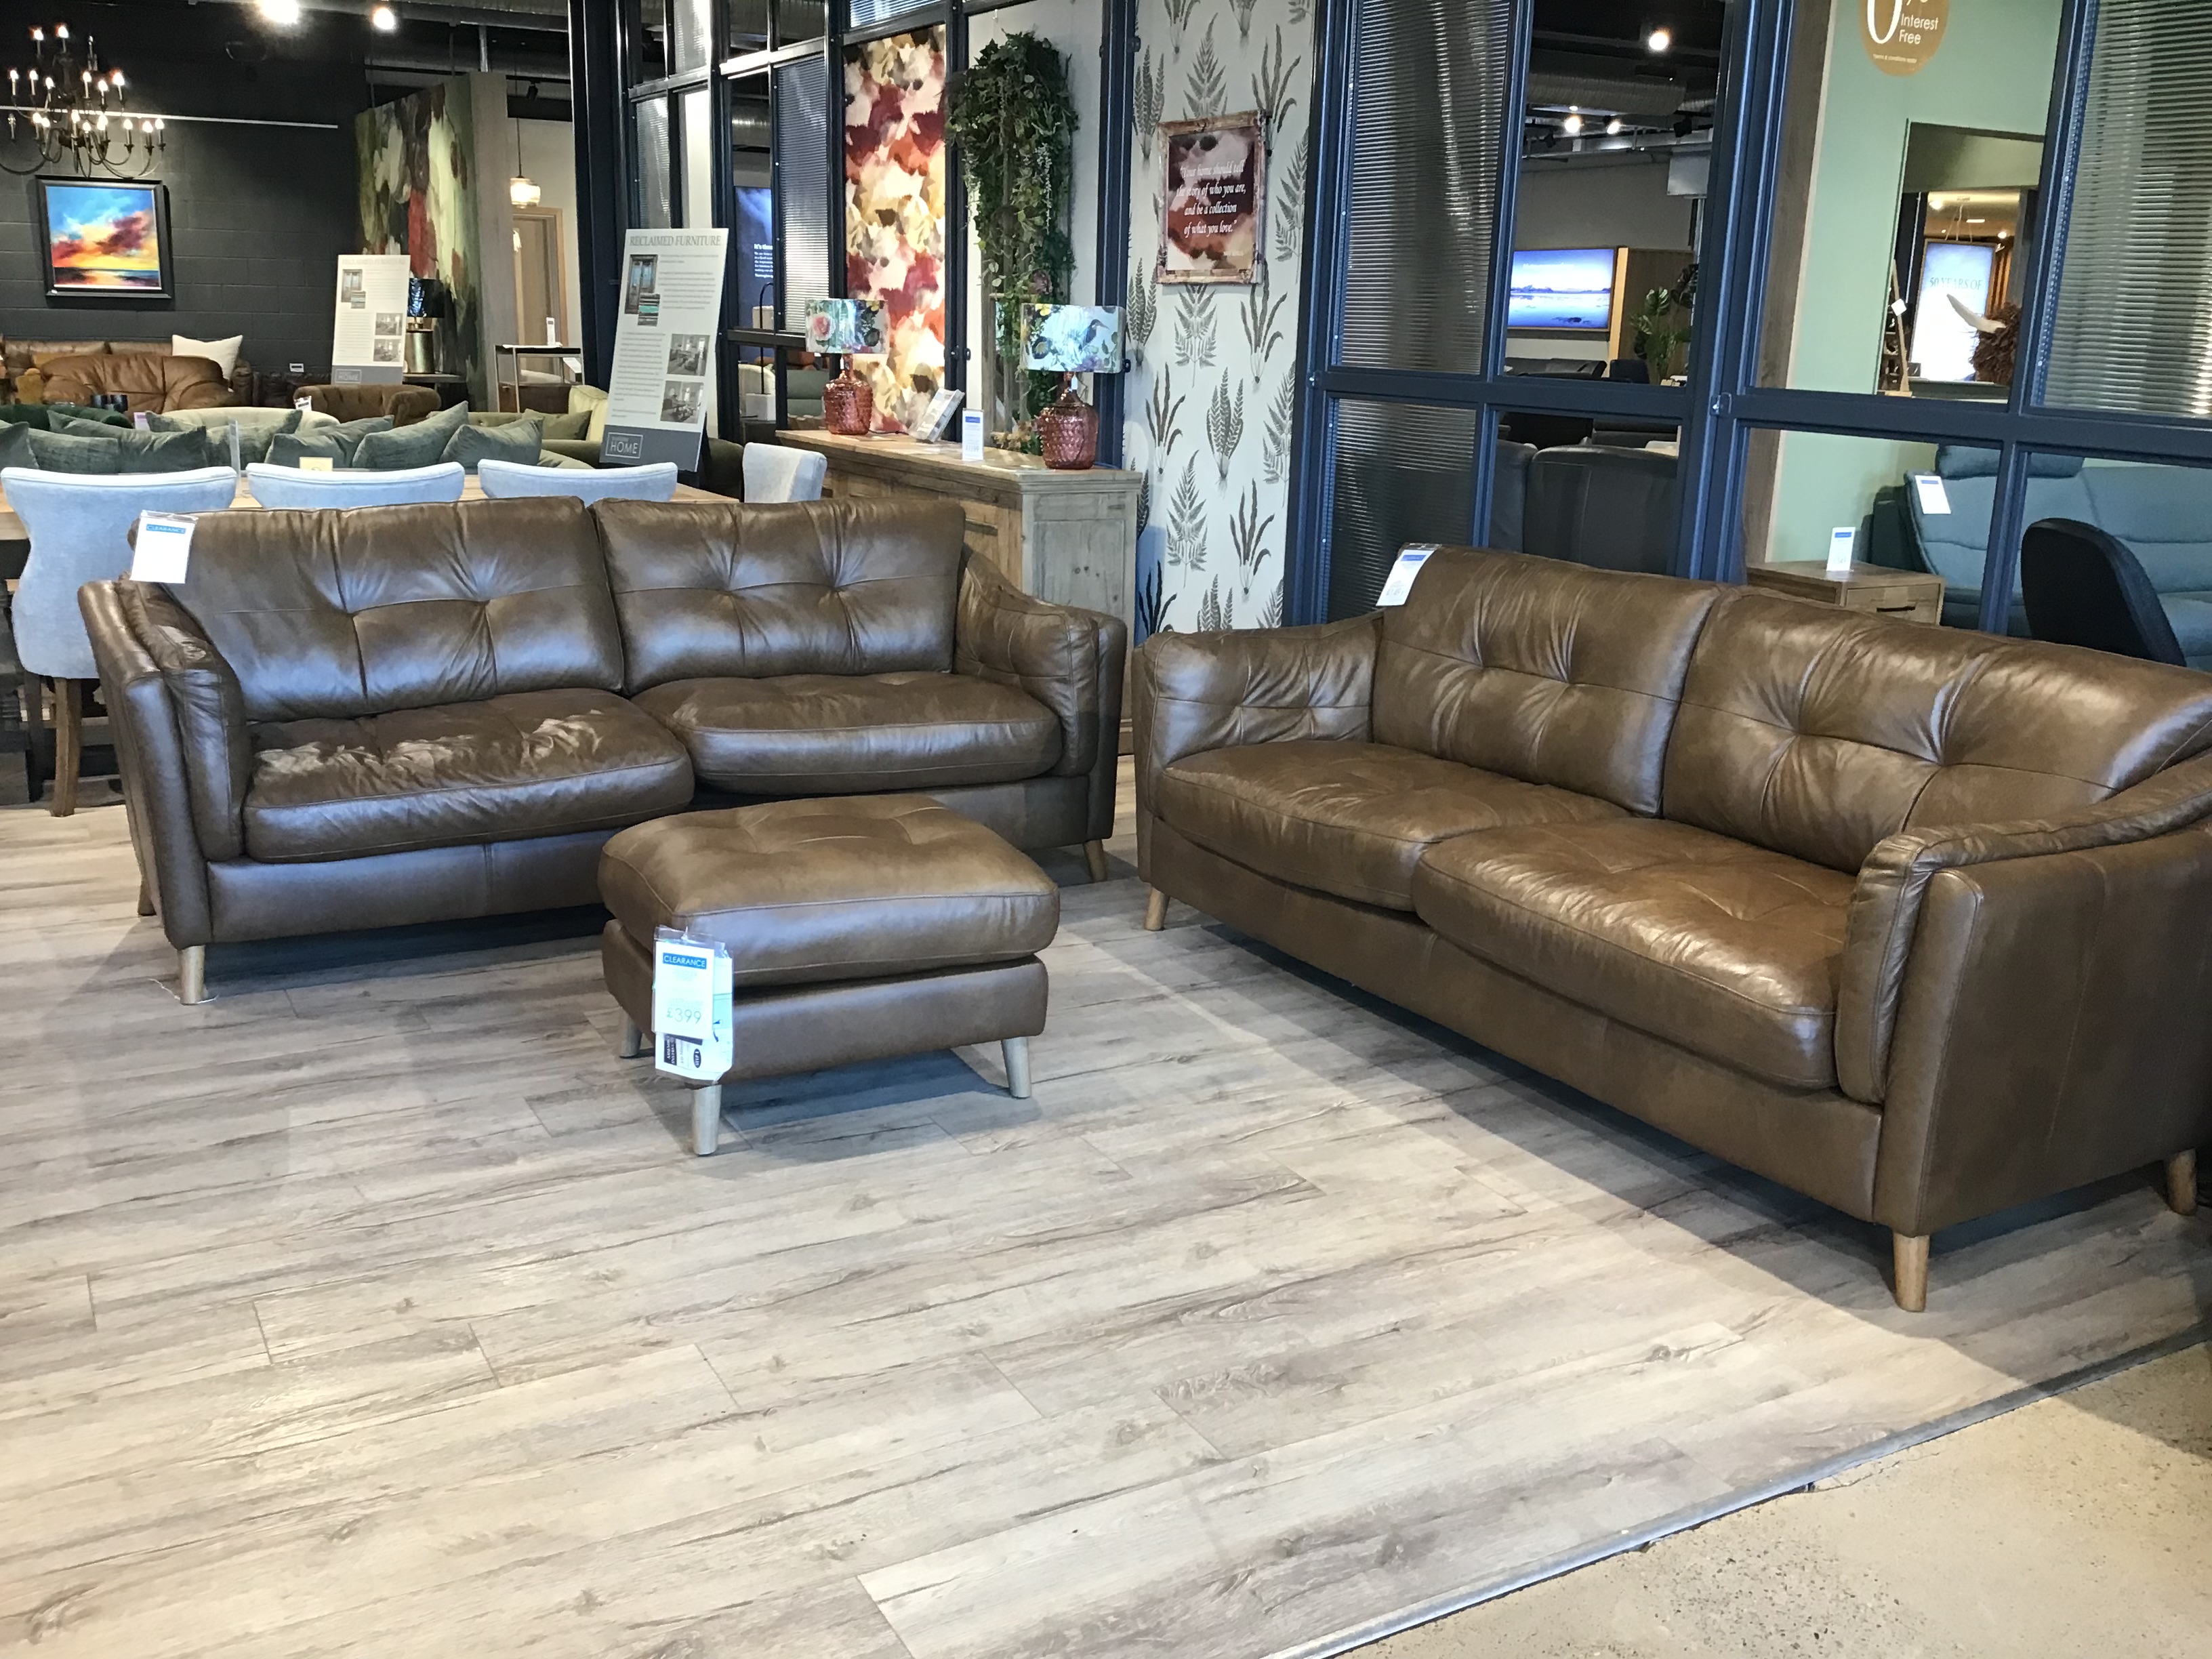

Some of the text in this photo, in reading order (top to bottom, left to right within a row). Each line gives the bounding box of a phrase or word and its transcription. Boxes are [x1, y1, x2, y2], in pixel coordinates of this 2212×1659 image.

[1900, 13, 1939, 30] Interest
[1898, 29, 1921, 45] Free
[1210, 182, 1222, 194] who
[1222, 186, 1234, 198] you
[1185, 201, 1237, 216] and be a collection
[1184, 222, 1192, 238] of
[1192, 221, 1206, 234] what
[1206, 224, 1218, 237] you
[630, 234, 722, 246] RECLAIMED FURNITURE
[1970, 279, 1983, 291] OF
[610, 441, 638, 454] HOME
[664, 955, 705, 968] CLEARANCE
[666, 1007, 702, 1025] £399
